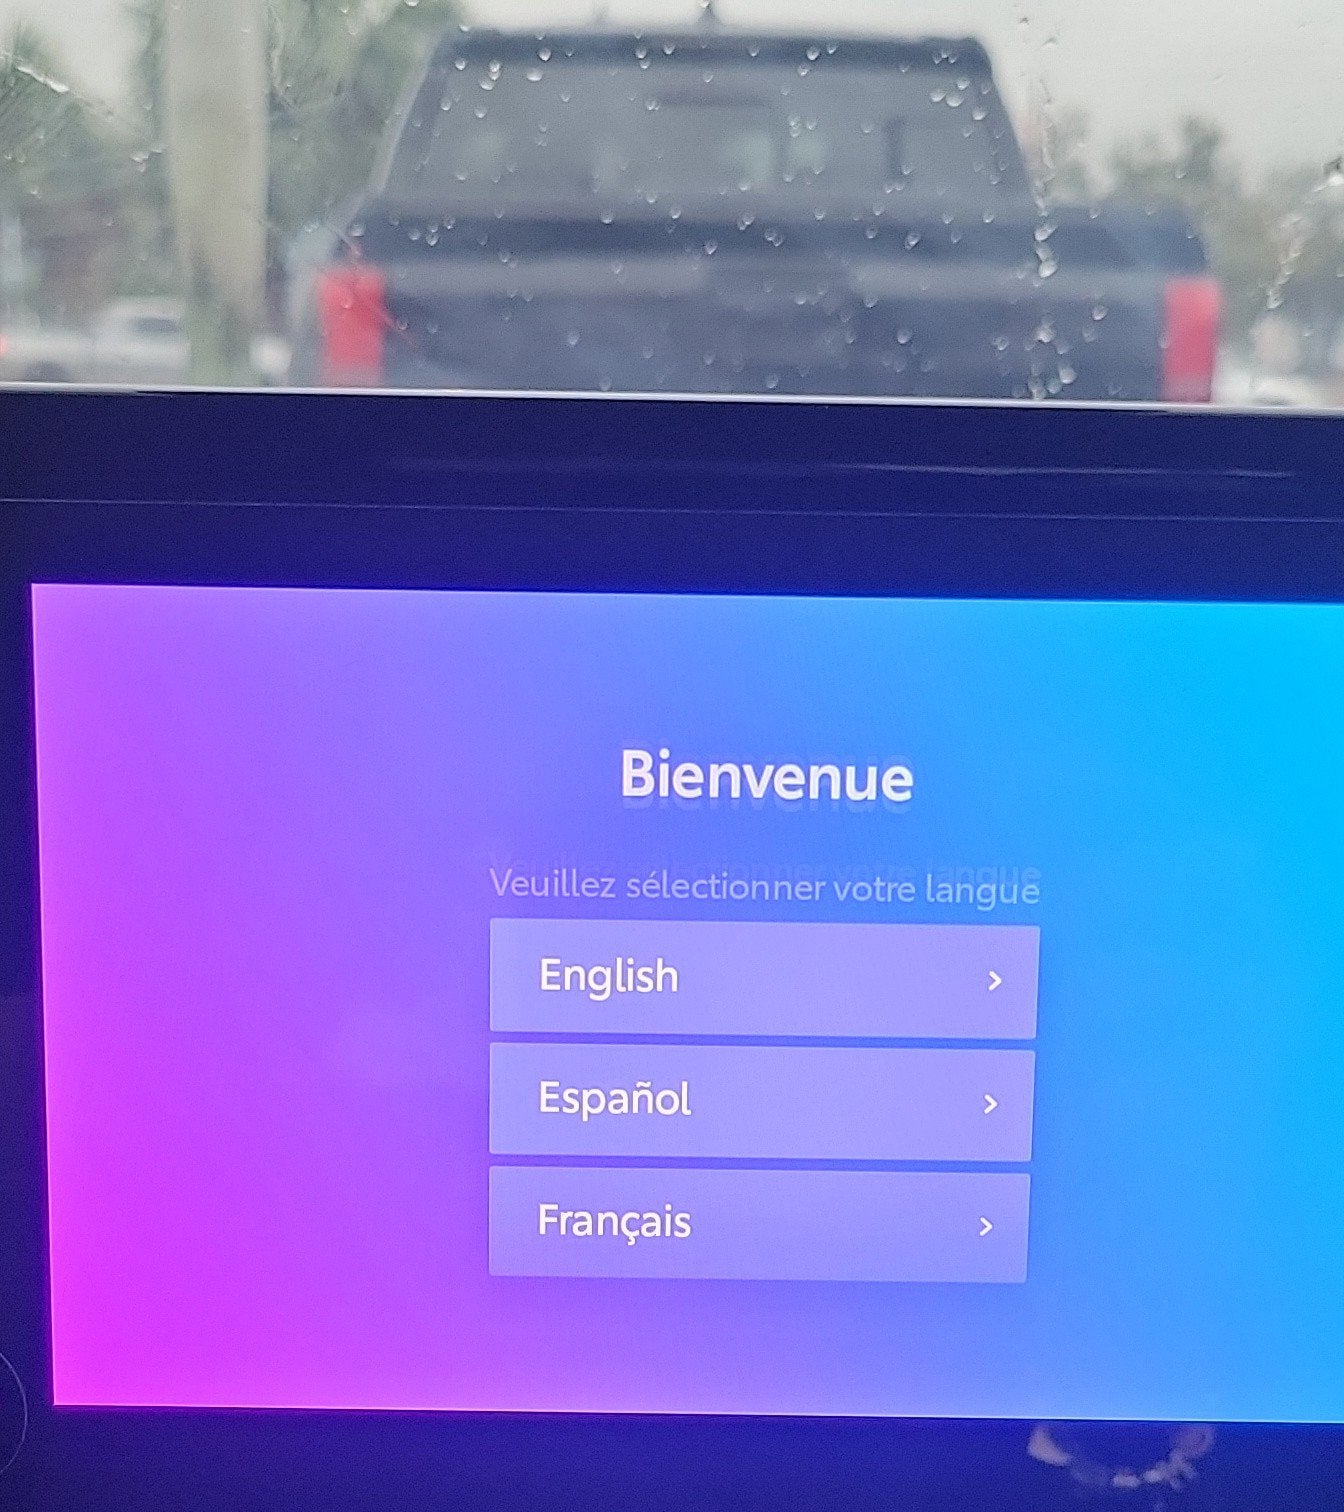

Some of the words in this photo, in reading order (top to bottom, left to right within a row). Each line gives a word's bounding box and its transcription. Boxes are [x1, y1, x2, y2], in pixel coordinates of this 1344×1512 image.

[623, 748, 913, 801] Bienvenue
[488, 867, 615, 898] Veuillez
[626, 869, 825, 901] sélectionner
[833, 876, 915, 902] votre
[926, 874, 1040, 911] langue
[541, 957, 678, 1001] English
[540, 1081, 691, 1122] Español
[539, 1203, 691, 1246] Français
